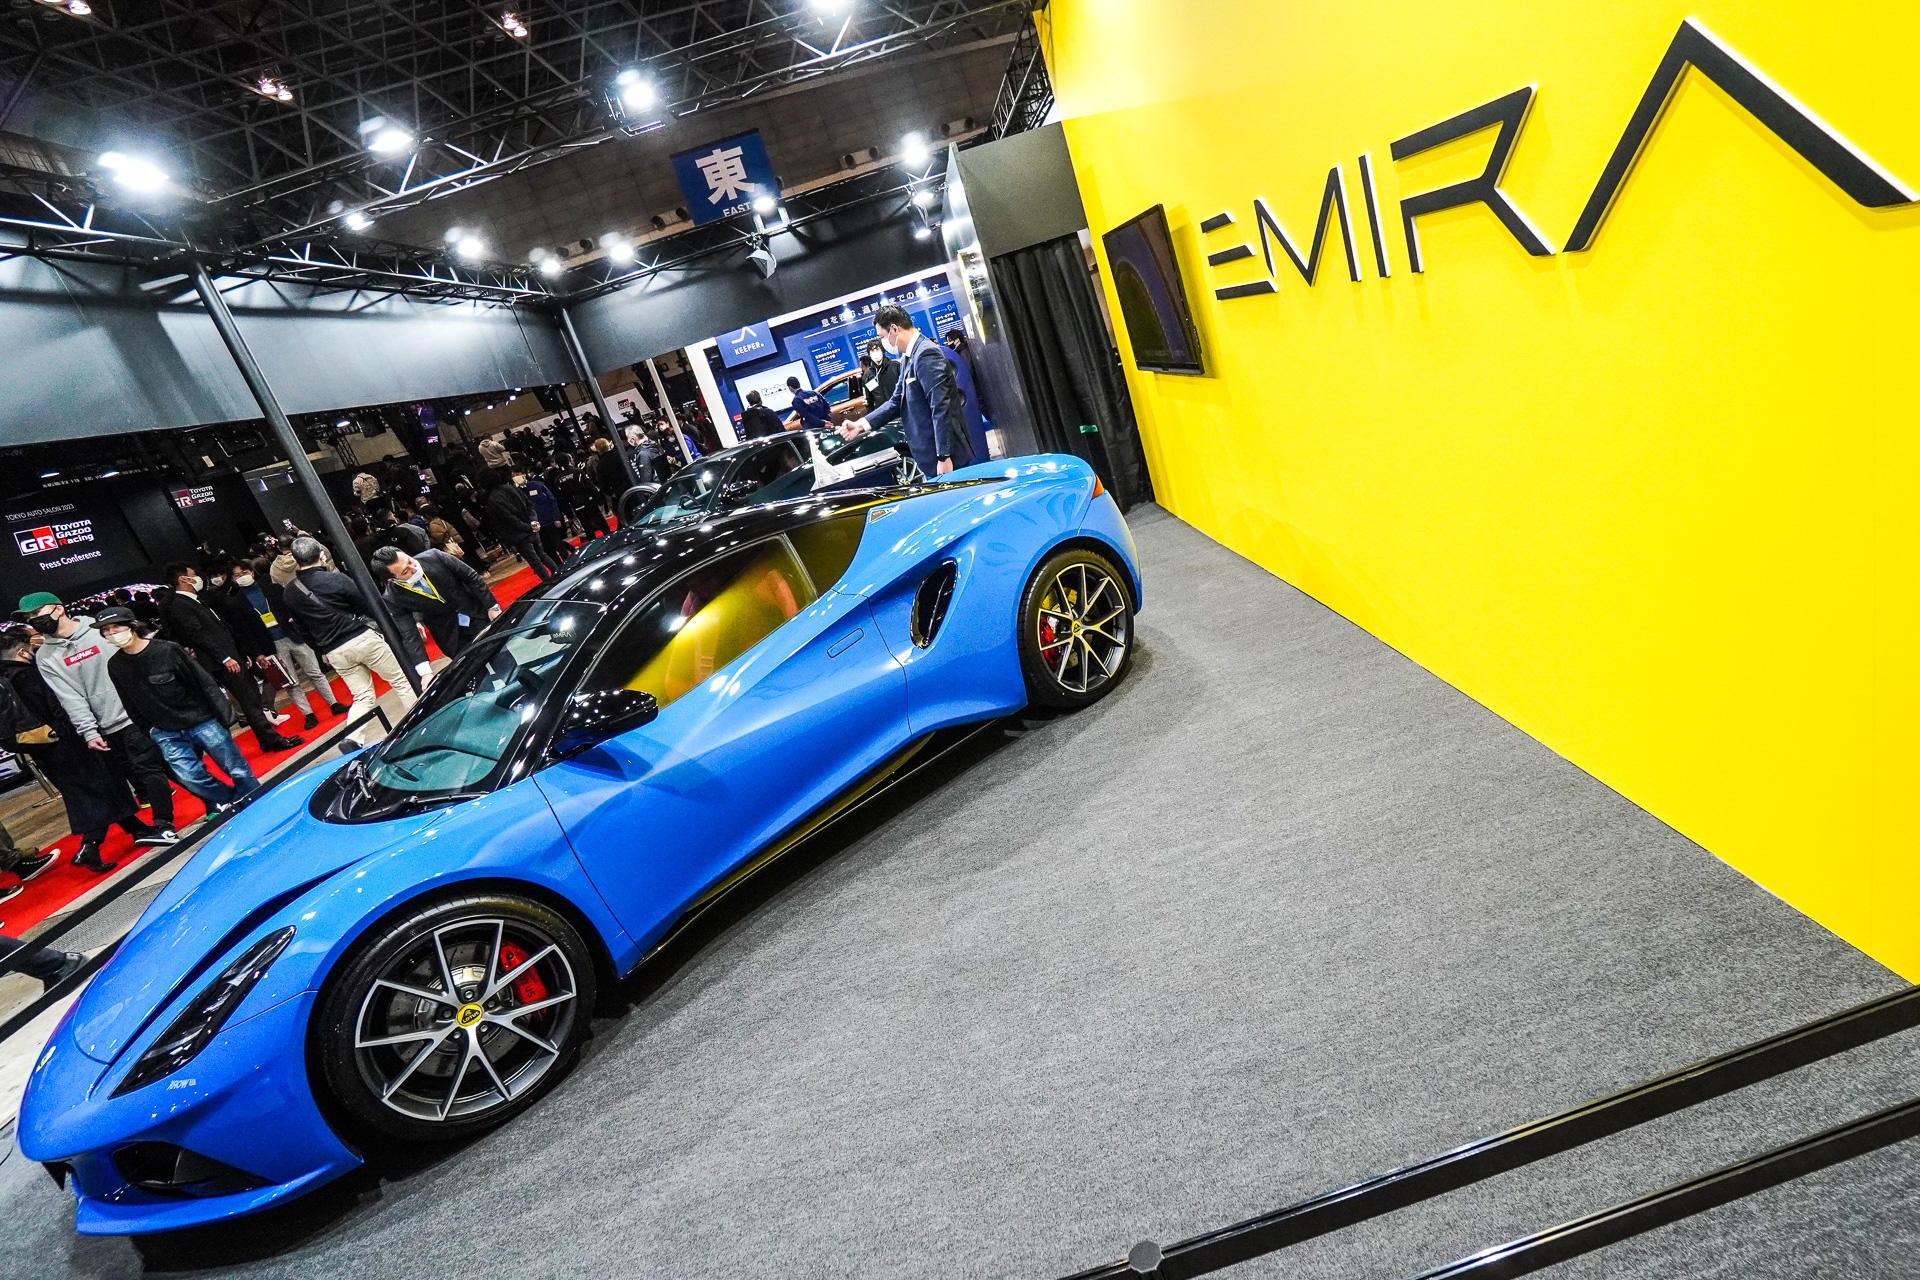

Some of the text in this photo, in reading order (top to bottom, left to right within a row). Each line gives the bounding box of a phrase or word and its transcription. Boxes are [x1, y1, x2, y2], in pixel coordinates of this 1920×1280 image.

[1201, 16, 1920, 300] EMIRA
[695, 146, 754, 205] 東
[723, 201, 752, 217] EAST
[5, 503, 75, 521] TOKYO AUTO SALON 2023
[52, 519, 92, 532] TOYOTA
[55, 526, 92, 539] GAZOO
[20, 535, 57, 553] GR
[58, 533, 95, 546] Racing
[39, 550, 102, 571] Press Conference
